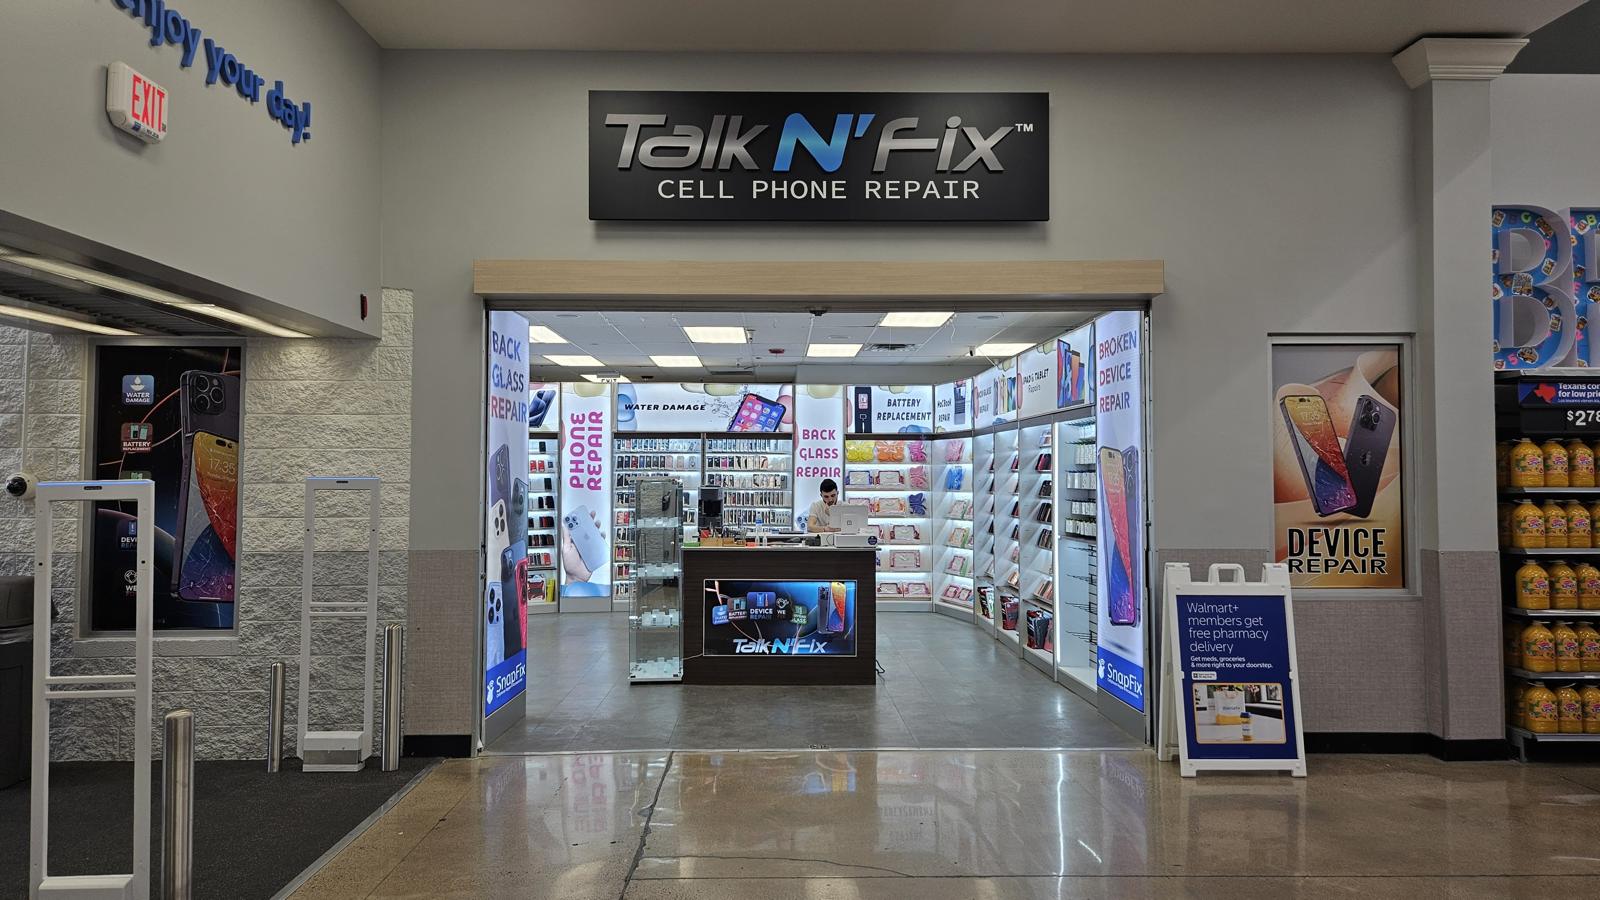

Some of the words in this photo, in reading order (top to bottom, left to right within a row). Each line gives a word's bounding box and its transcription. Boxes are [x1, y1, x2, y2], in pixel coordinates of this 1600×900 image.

[115, 0, 201, 67] njoy
[204, 38, 265, 102] your
[266, 81, 311, 143] day!
[132, 74, 165, 132] EXIT
[604, 113, 769, 170] Talk
[657, 179, 735, 199] CELL
[752, 179, 847, 199] PHONE
[865, 179, 980, 199] REPAIR
[492, 331, 521, 362] BACK
[1099, 330, 1137, 360] BROKEN
[492, 364, 524, 393] GLASS
[1035, 368, 1049, 381] TABLET
[1099, 362, 1131, 387] DEVICE
[1558, 382, 1586, 390] Texans
[1558, 390, 1570, 398] for
[1571, 390, 1586, 398] low
[491, 395, 527, 424] REPAIR
[887, 398, 921, 408] BATTERY
[1099, 391, 1130, 414] REPAIR
[877, 412, 931, 421] REPLACEMENT
[802, 429, 836, 441] BACK
[569, 412, 586, 489] PHONE
[587, 411, 603, 491] REPAIR
[799, 448, 839, 460] GLASS
[796, 466, 841, 478] REPAIR
[1287, 527, 1387, 558] DEVICE
[1287, 558, 1388, 575] REPAIR
[1186, 602, 1239, 613] Walmart+
[1188, 615, 1242, 626] members
[1244, 616, 1264, 628] get
[1189, 627, 1211, 639] free
[1213, 628, 1269, 642] pharmacy
[733, 638, 771, 655] Talk
[1189, 641, 1234, 654] delivery
[1107, 663, 1143, 696] SnapFix
